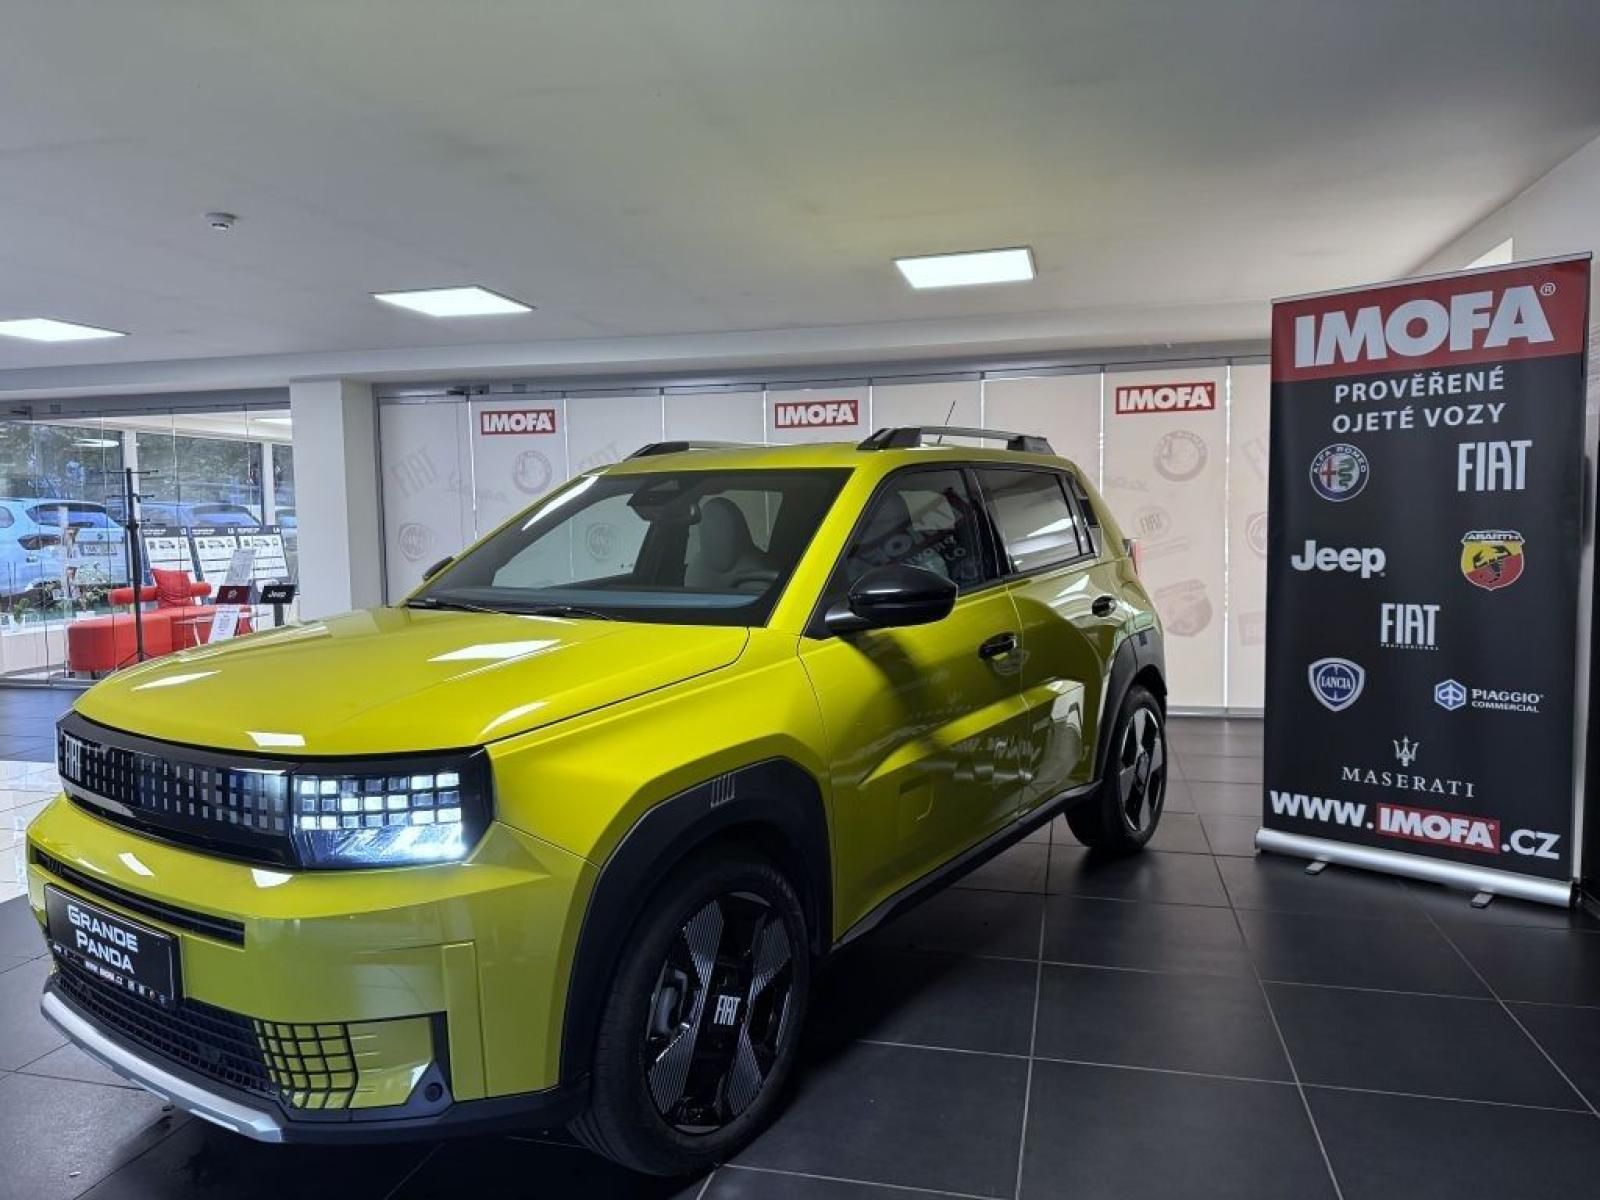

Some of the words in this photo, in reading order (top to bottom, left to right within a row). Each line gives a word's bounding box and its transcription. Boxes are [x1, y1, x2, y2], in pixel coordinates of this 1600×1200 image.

[1294, 285, 1554, 368] IMOFA
[1119, 386, 1211, 410] IMOFA
[1335, 366, 1504, 403] PROVĚŘENÉ
[483, 412, 552, 432] IMOFA
[777, 403, 855, 425] IMOFA
[1332, 406, 1414, 433] OJETÉ
[1425, 402, 1506, 428] VOZY
[1457, 440, 1533, 492] FIAT
[1291, 539, 1386, 579] Jeep
[1380, 602, 1441, 646] FIAT
[1320, 675, 1352, 690] LANCIA
[1471, 688, 1541, 704] PIAGGIO
[1471, 700, 1540, 713] COMMERCIAL
[1341, 766, 1475, 798] MASERATI
[67, 904, 138, 953] GRANDE
[75, 929, 135, 974] PANDA
